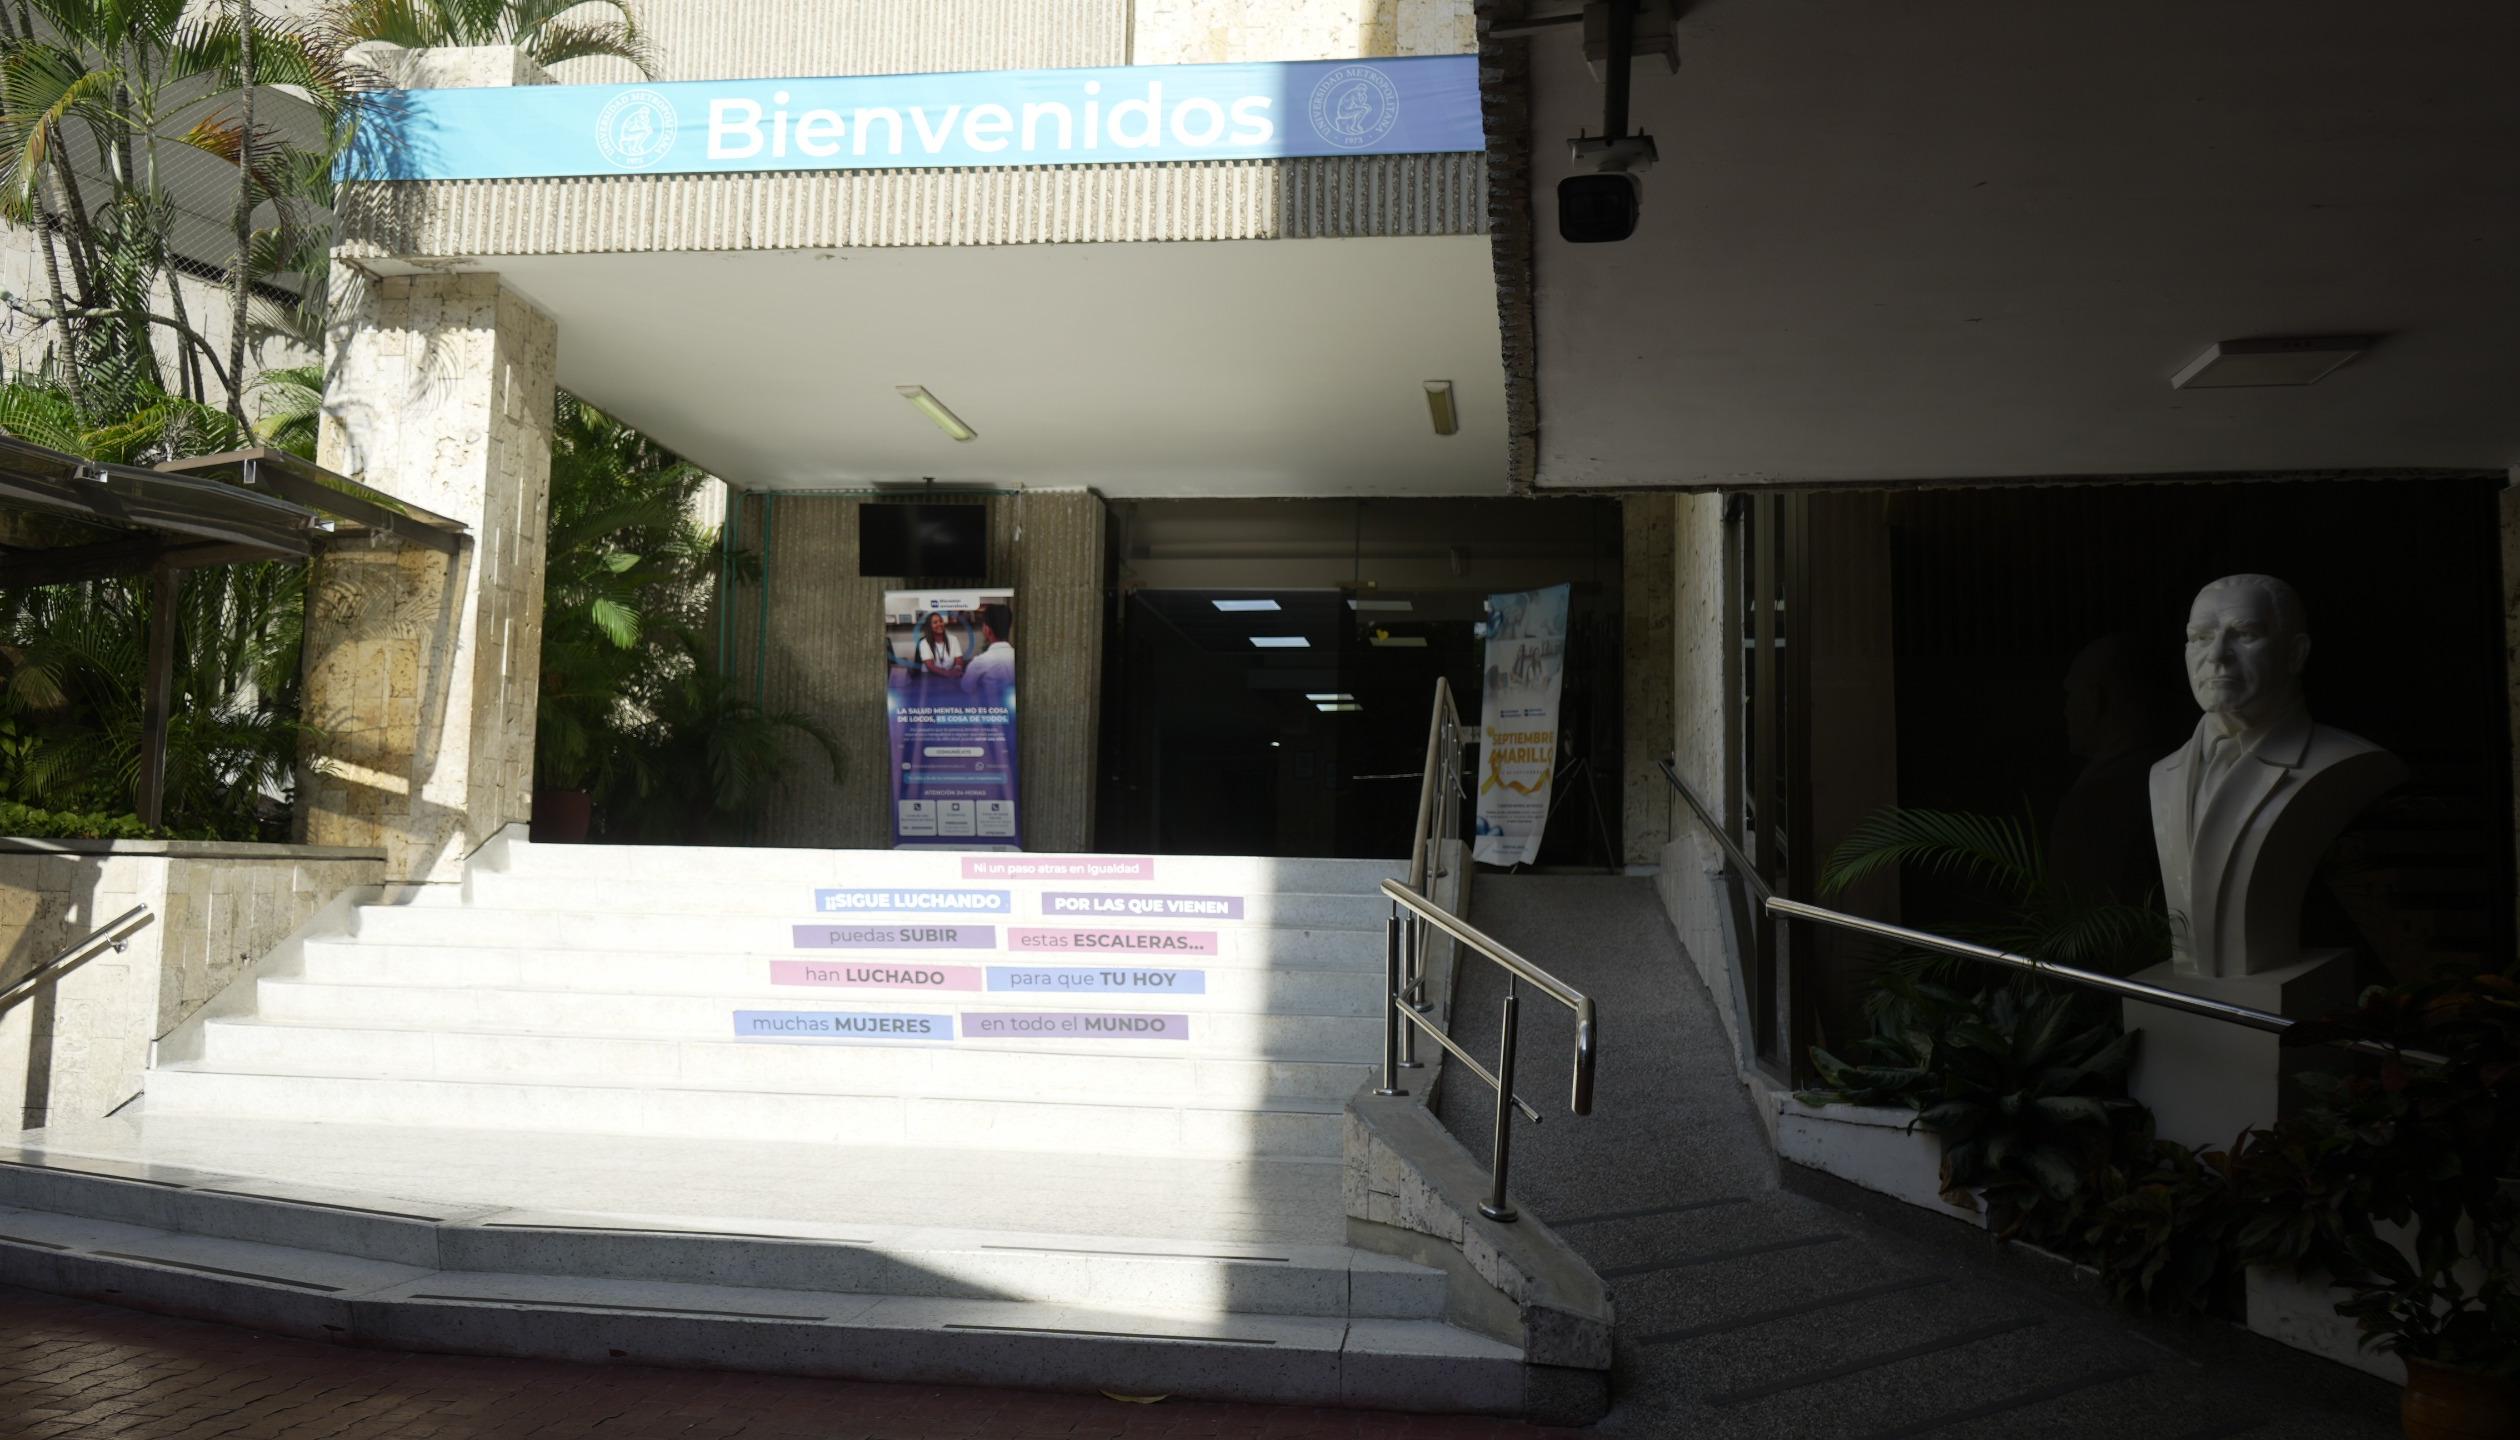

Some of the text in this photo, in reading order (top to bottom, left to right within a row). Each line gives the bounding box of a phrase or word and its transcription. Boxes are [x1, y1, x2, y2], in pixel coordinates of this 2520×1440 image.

[1312, 68, 1396, 137] UNIVERSIDAD METROPOLITANA
[707, 80, 1275, 160] Bienvenidos
[897, 707, 907, 715] LA
[908, 707, 933, 715] SALUD
[934, 707, 964, 715] MENTAL
[965, 707, 977, 715] NO
[897, 715, 908, 723] DE
[936, 715, 946, 723] ES
[947, 715, 969, 723] COSA
[970, 715, 981, 723] DE
[974, 863, 1140, 876] Ni un paso atras en Igualdad
[894, 893, 1001, 909] LUCHANDO
[1055, 897, 1229, 914] POR LAS QUE VIENEN
[830, 928, 958, 944] puedas SUBIR
[1021, 933, 1204, 951] estas ESCALERAS...
[805, 966, 945, 985] han LUCHADO
[1011, 972, 1176, 989] para que TU HOY
[752, 1015, 932, 1034] muchas MUJERES
[980, 1016, 1165, 1032] en todo el MUNDO
